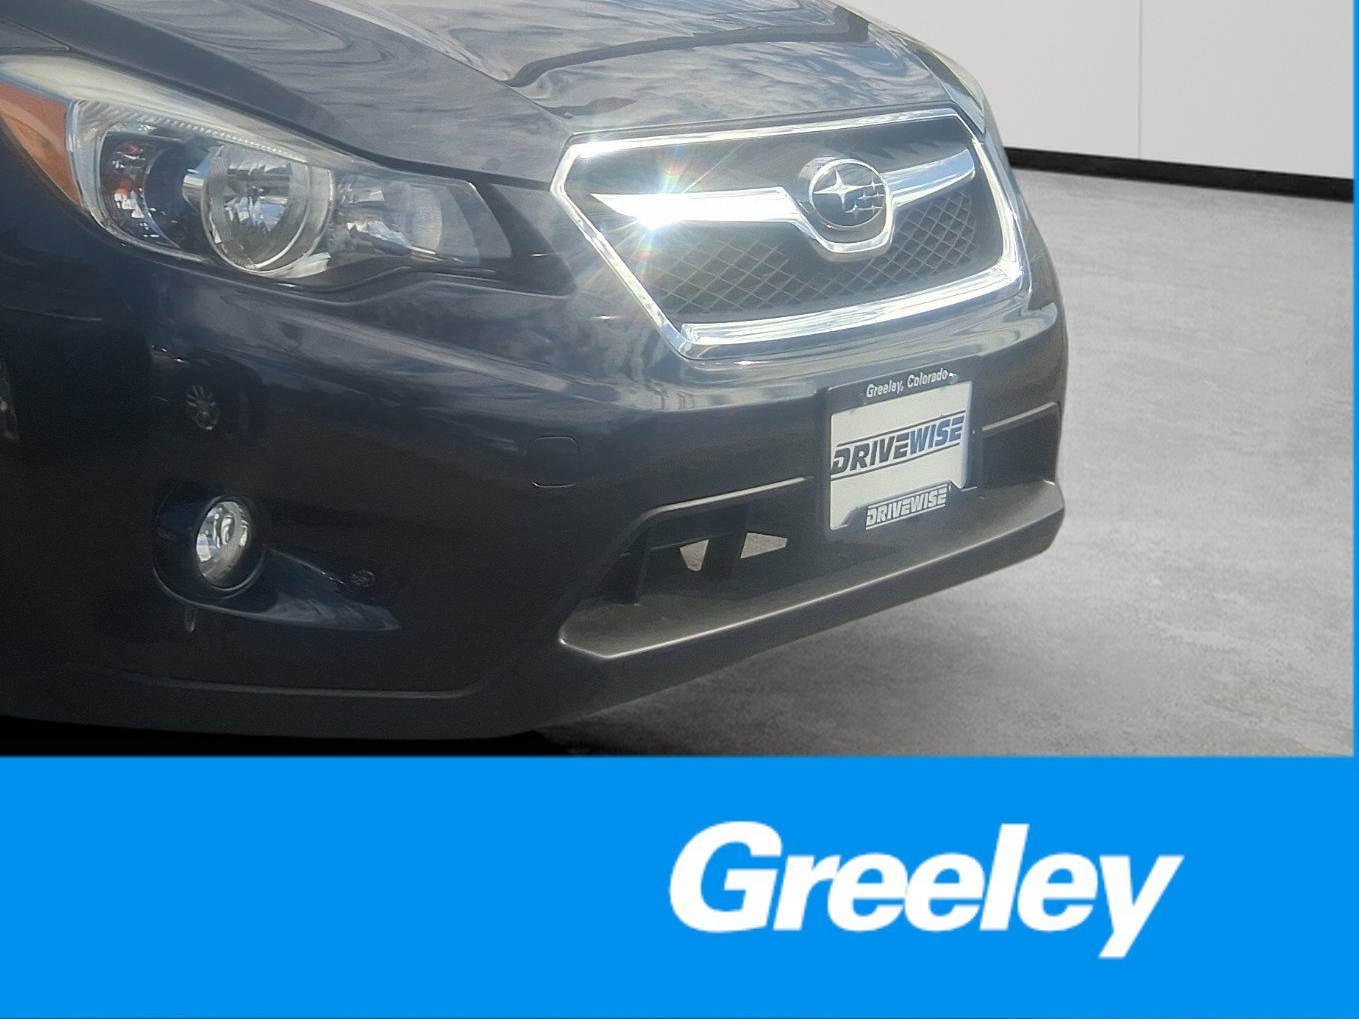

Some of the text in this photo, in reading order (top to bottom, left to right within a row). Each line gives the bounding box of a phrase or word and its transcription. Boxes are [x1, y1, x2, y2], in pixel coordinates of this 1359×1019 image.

[866, 367, 949, 398] Greeley, Colorado
[831, 415, 965, 475] DRIVEWISE
[866, 488, 947, 526] DRIVEWISE
